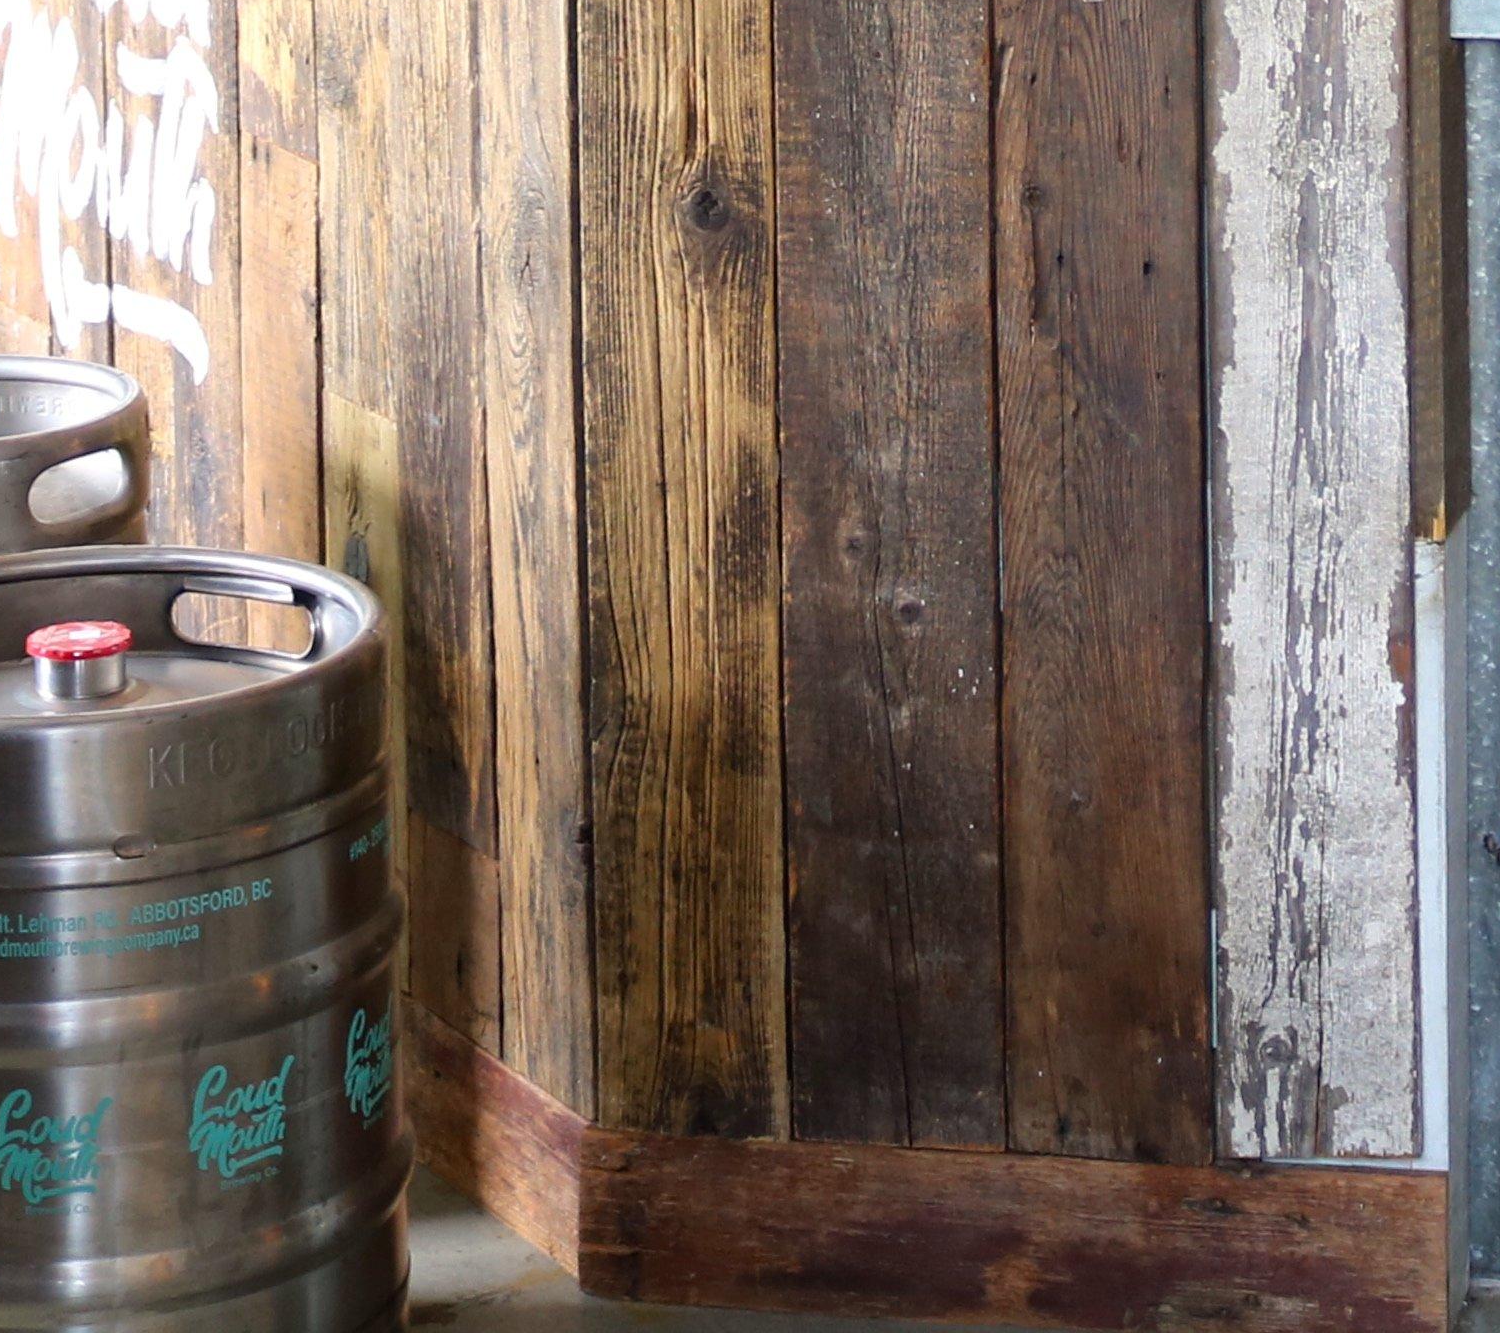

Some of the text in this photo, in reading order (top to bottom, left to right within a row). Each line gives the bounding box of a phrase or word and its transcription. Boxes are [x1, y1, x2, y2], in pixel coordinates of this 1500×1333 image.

[131, 886, 249, 926] ABBOTSFORD,
[251, 877, 273, 902] BC
[188, 1054, 296, 1136] Loud
[190, 1102, 286, 1179] Mouth
